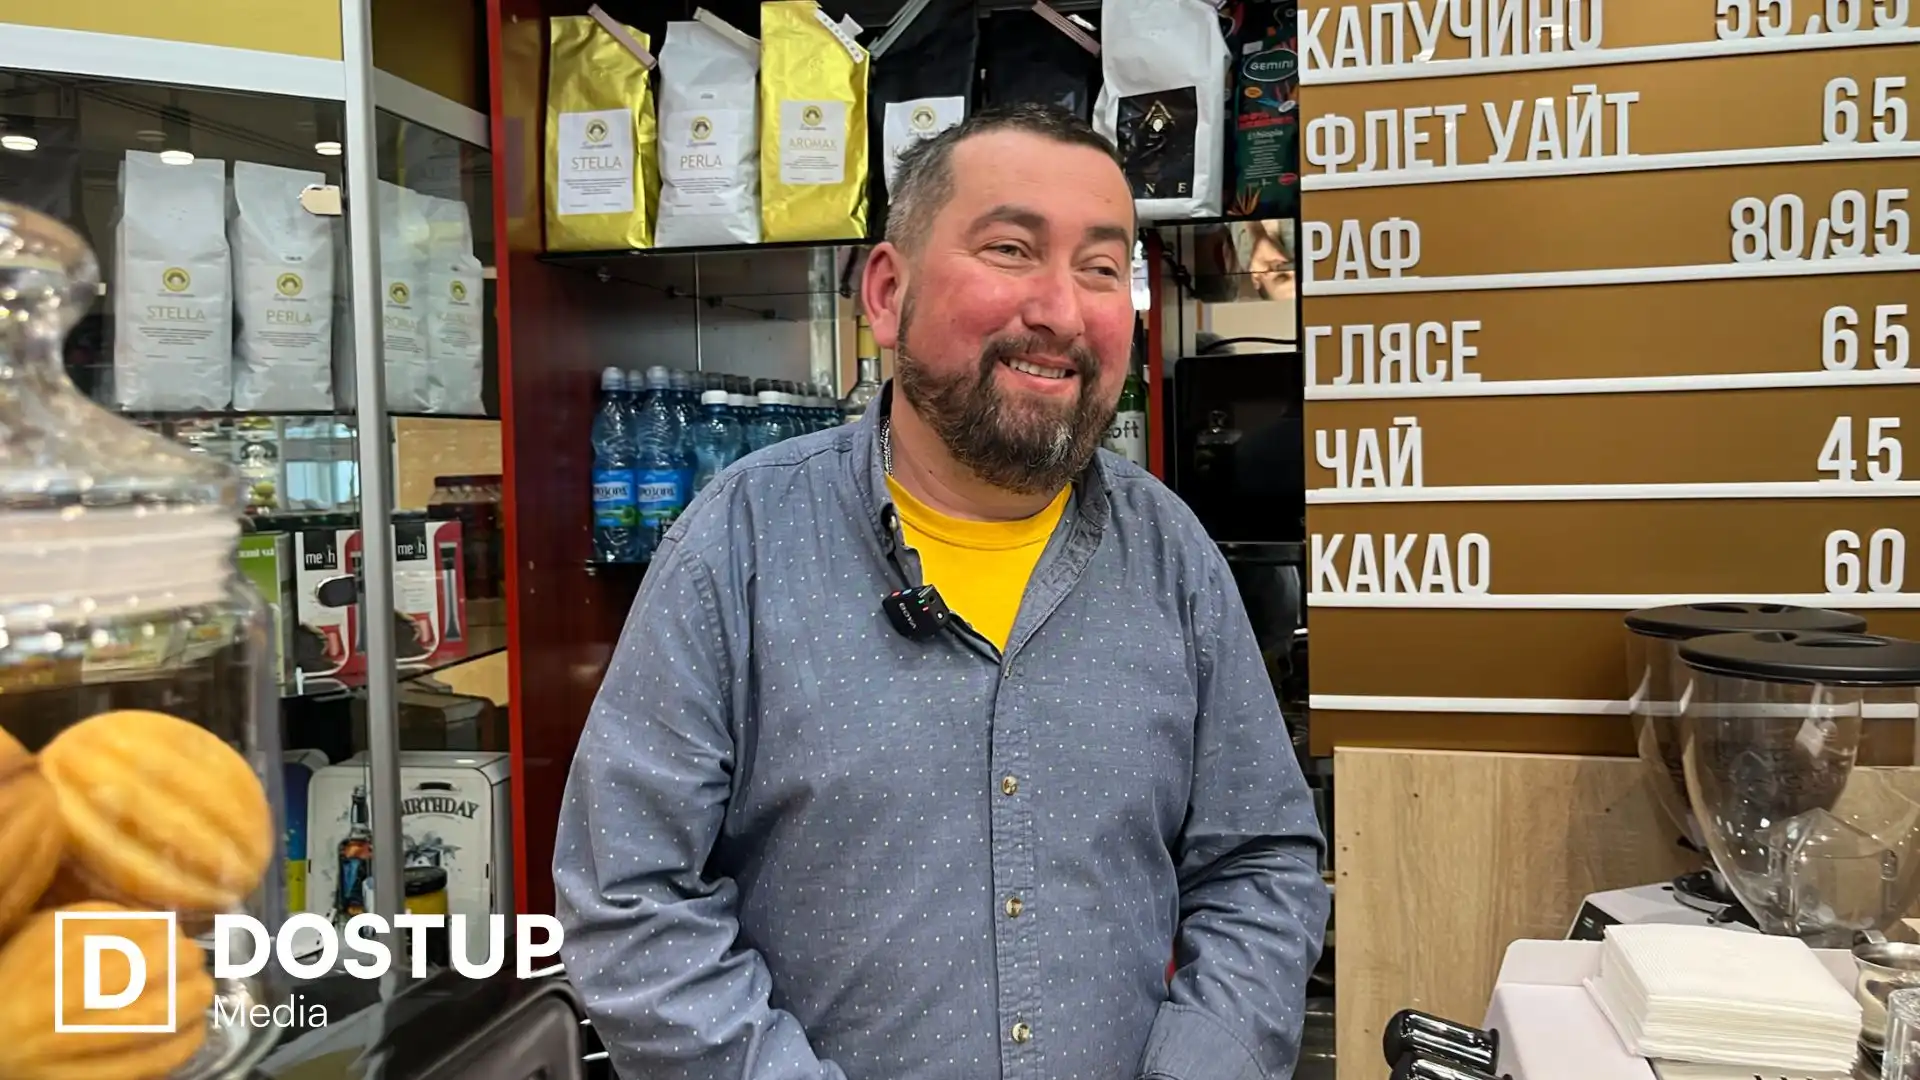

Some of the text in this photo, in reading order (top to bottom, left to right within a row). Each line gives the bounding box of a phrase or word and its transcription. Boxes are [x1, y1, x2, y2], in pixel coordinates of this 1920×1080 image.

[1298, 0, 1603, 70] КАПУЧИНО
[1306, 104, 1466, 174] ФЛЕТ
[1482, 85, 1639, 165] УАЙТ
[1823, 77, 1907, 145] 65
[571, 155, 622, 170] STELLA
[680, 153, 722, 168] PERLA
[1303, 217, 1420, 281] РАФ
[1731, 189, 1909, 264] 80,95
[147, 305, 206, 321] STELLA
[266, 309, 313, 324] PERLA
[1822, 304, 1909, 370] 65
[1305, 320, 1481, 386] ГЛЯСЕ
[1108, 420, 1139, 438] oft
[1315, 416, 1423, 489] ЧАЙ
[1817, 416, 1903, 482] 45
[1310, 533, 1490, 595] КАКАО
[1825, 528, 1906, 595] 60
[899, 602, 917, 629] BOYA
[401, 796, 479, 820] IRTHDAY
